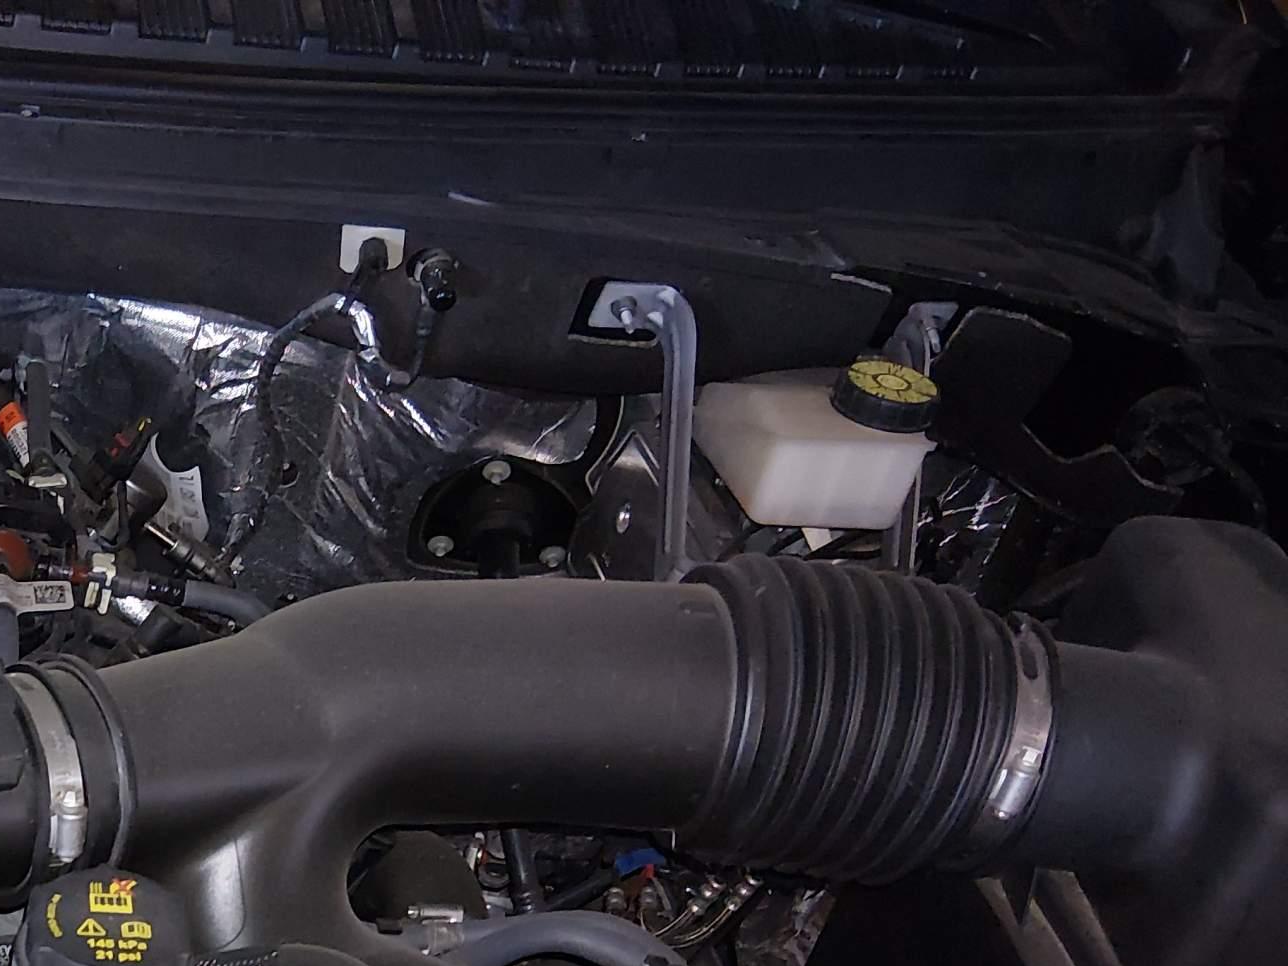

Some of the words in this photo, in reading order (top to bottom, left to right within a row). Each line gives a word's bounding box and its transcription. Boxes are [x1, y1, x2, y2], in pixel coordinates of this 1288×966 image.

[118, 939, 147, 950] kPa
[95, 950, 113, 960] 21
[118, 952, 141, 962] psi
